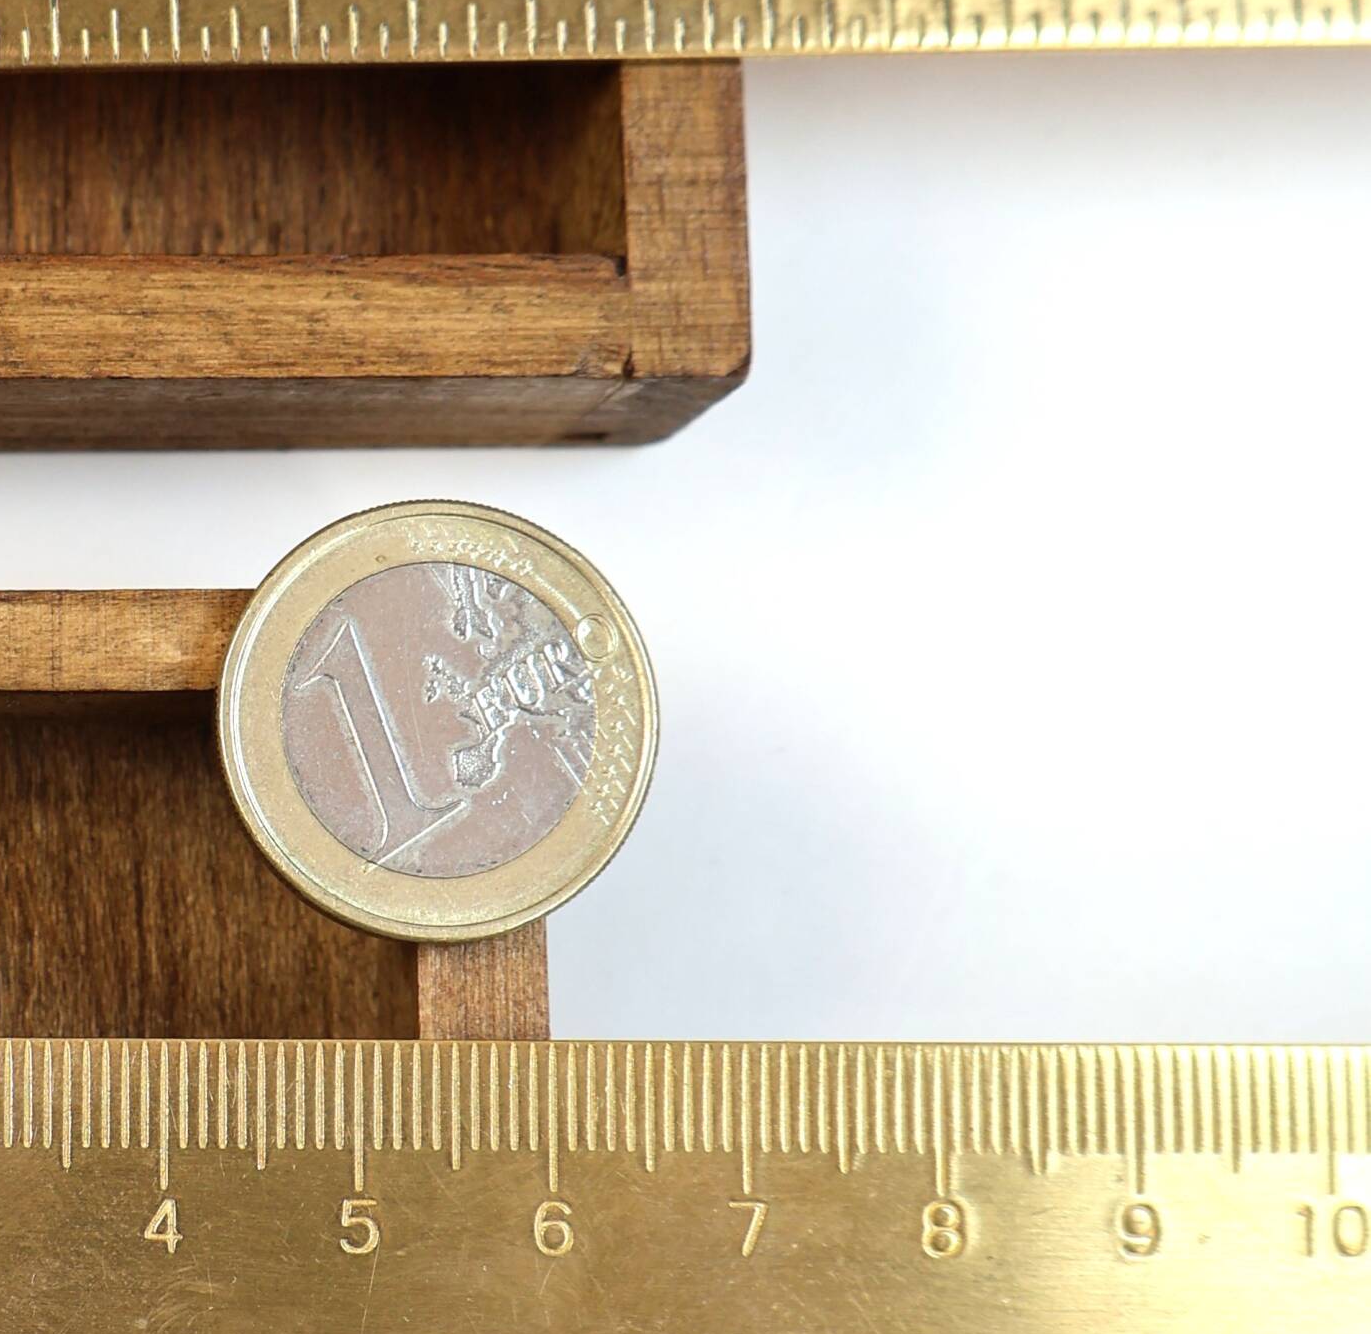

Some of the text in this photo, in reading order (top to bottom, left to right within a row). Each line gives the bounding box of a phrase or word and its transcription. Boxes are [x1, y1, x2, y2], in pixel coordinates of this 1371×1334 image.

[294, 617, 468, 874] 1
[143, 1198, 183, 1253] 4
[340, 1198, 380, 1254] 5
[532, 1200, 575, 1257] 6
[728, 1200, 769, 1257] 7
[922, 1201, 966, 1258] 8
[1118, 1202, 1160, 1257] 9
[1297, 1203, 1369, 1257] 10
